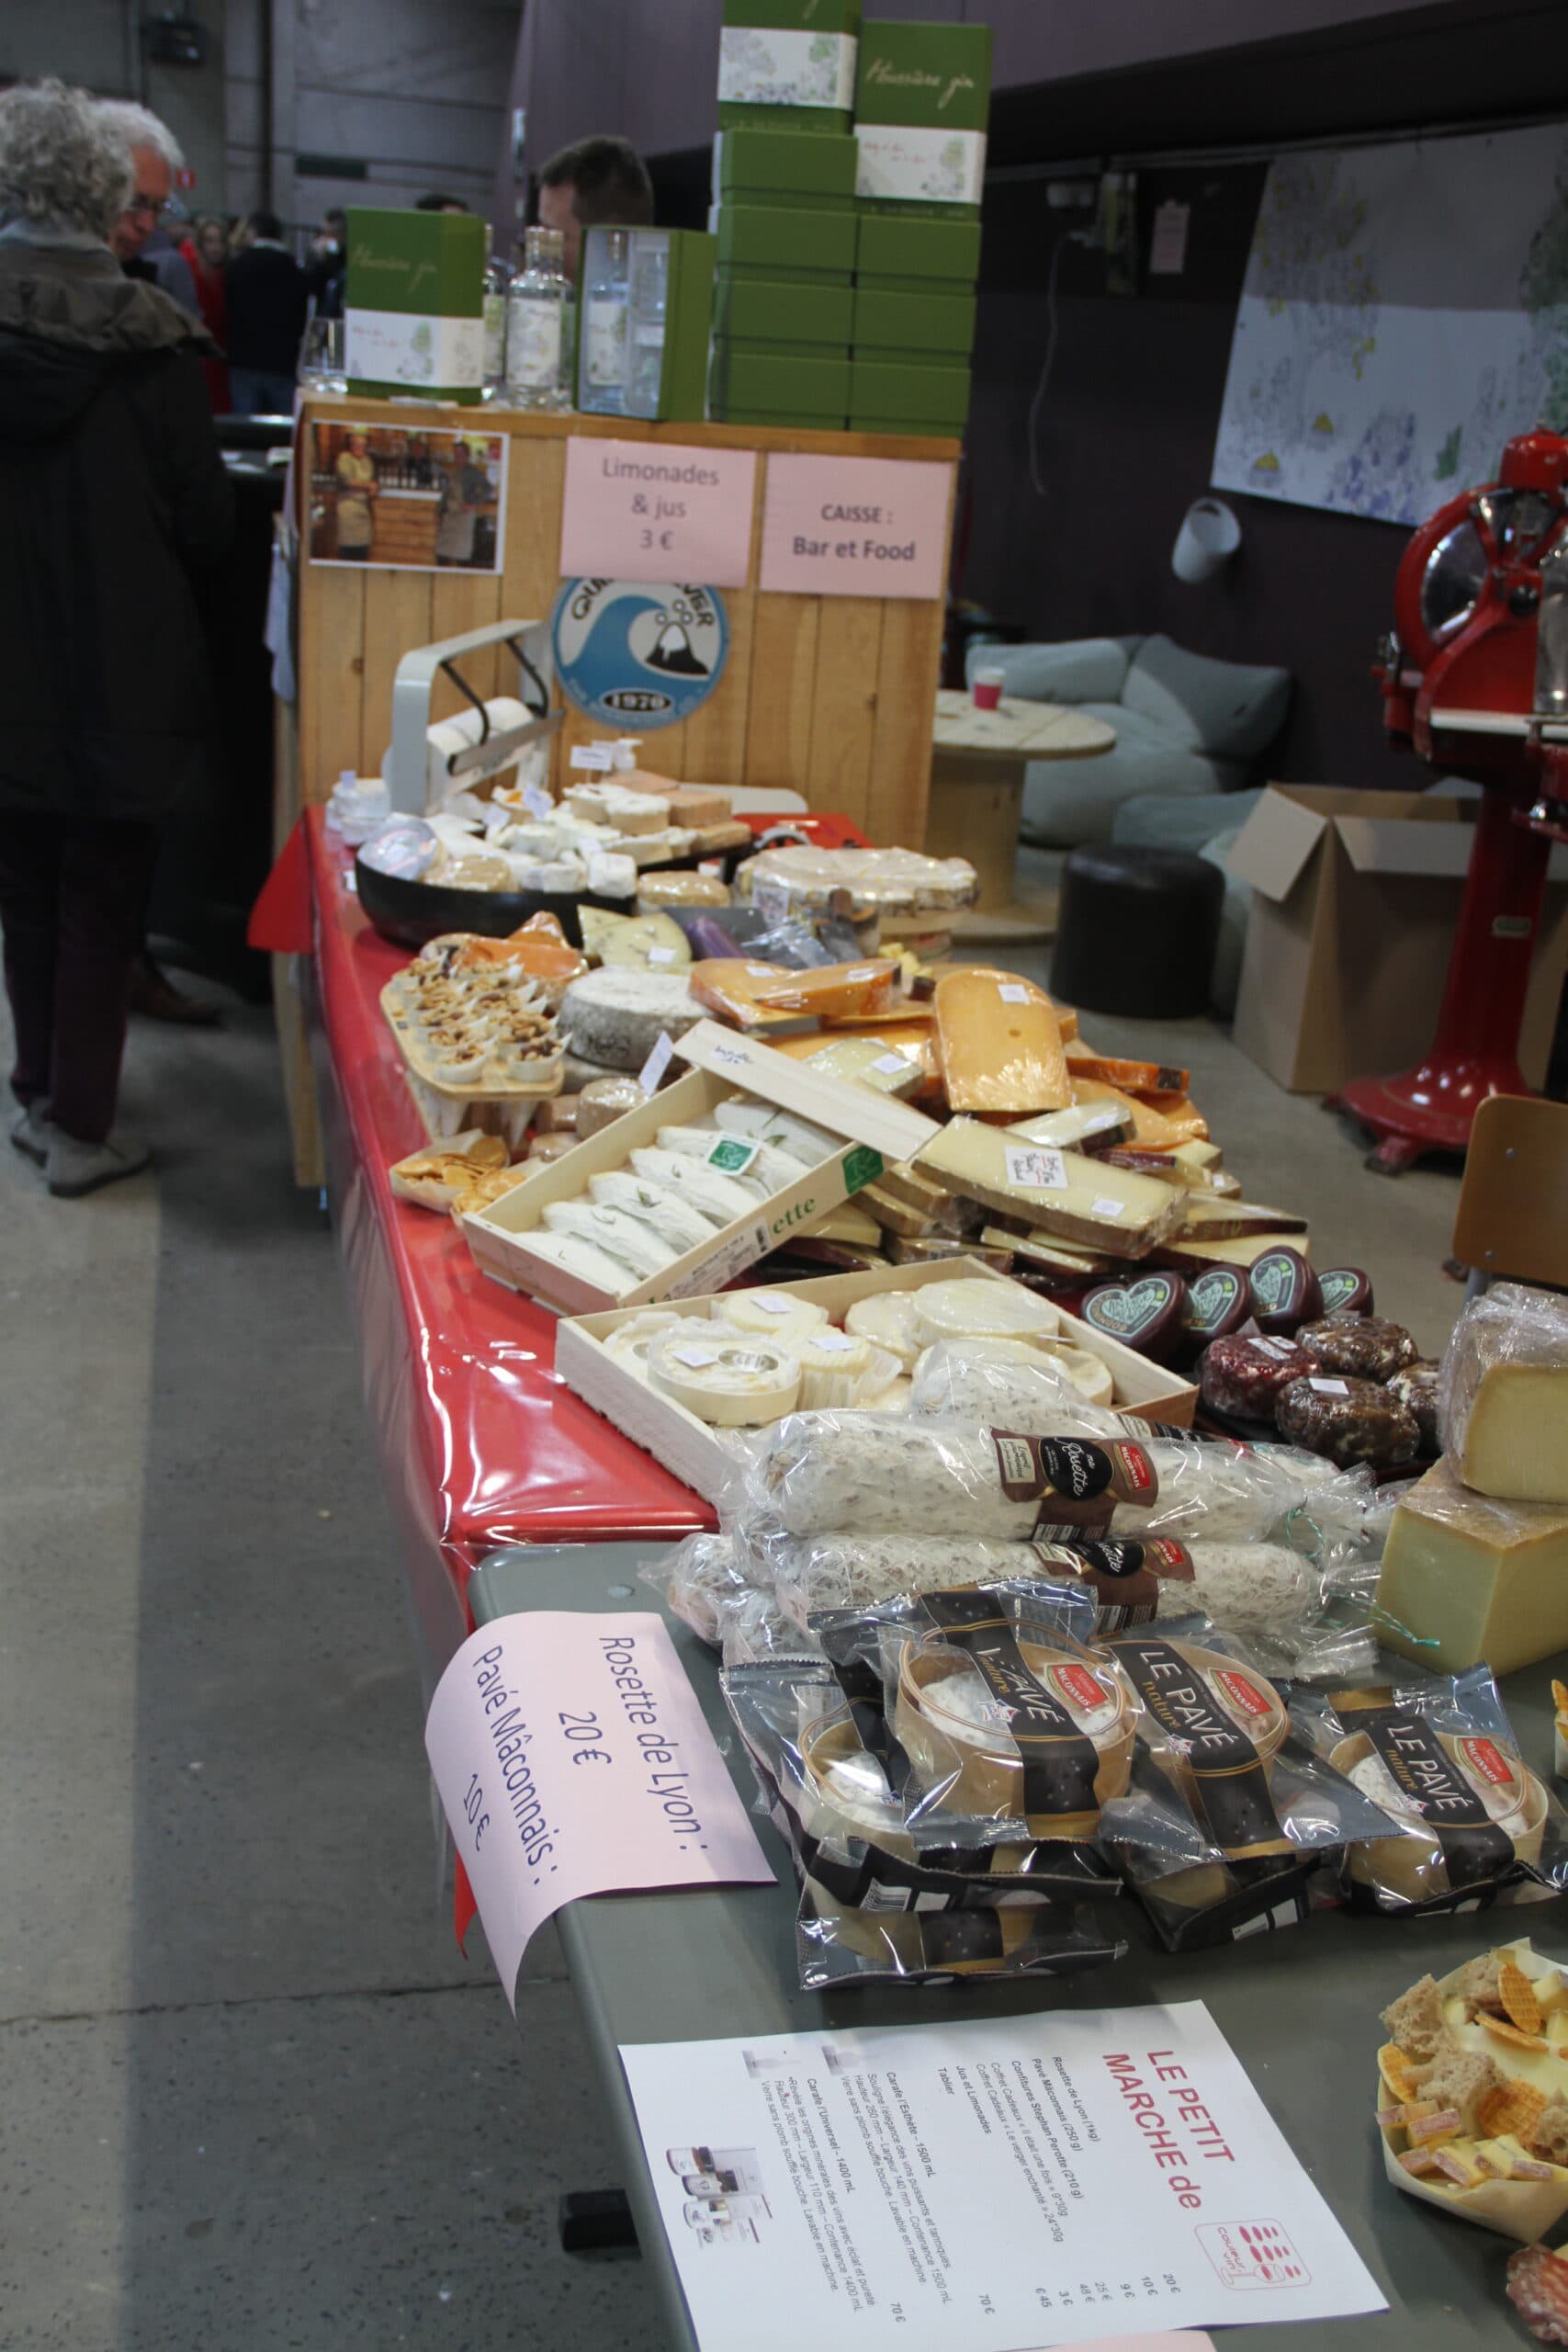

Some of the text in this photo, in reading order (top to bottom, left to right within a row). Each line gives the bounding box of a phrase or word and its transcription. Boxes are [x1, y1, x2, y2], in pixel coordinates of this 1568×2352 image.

[602, 458, 719, 486] Limonades
[631, 494, 687, 520] & jus
[821, 504, 882, 524] CAISSE
[640, 529, 673, 550] 3 €
[793, 537, 915, 561] Bar et Food
[1054, 1436, 1089, 1497] Rosette
[1139, 1652, 1182, 1679] LE
[1166, 1687, 1240, 1748] PAVÉ
[472, 1645, 560, 1867] Pavé Mâconnais
[558, 1711, 613, 1765] 20 €
[599, 1637, 702, 1834] Rosette de Lyon
[1387, 1725, 1427, 1752] LE
[1407, 1759, 1474, 1811] PAVÉ
[807, 2078, 824, 2106] Carafe
[955, 2065, 968, 2080] Jus
[963, 2081, 974, 2091] et
[966, 2090, 992, 2134] Limonades
[1010, 2060, 1035, 2102] Confitures
[1047, 2137, 1067, 2168] Perotte
[1061, 2169, 1080, 2188] (210
[1101, 2053, 1201, 2209] MARCHE de
[1146, 2050, 1235, 2162] LE PETIT
[836, 2157, 852, 2178] 1400
[843, 2179, 856, 2194] mL
[886, 2072, 904, 2098] Carafe
[915, 2143, 931, 2164] 1500
[924, 2165, 937, 2178] mL
[978, 2293, 992, 2306] 70
[937, 2066, 955, 2096] Tablier
[1040, 2295, 1053, 2308] 45
[976, 2064, 994, 2089] Coffret
[987, 2089, 1008, 2122] Cadeaux
[1005, 2131, 1016, 2142] Le
[1011, 2142, 1029, 2166] verger
[1079, 2283, 1092, 2295] 48
[990, 2062, 1008, 2087] Coffret
[1002, 2087, 1022, 2121] Cadeaux
[1032, 2154, 1045, 2169] une
[1040, 2169, 1053, 2185] fois
[1094, 2281, 1109, 2293] 25
[1051, 2056, 1072, 2087] Rosette
[1066, 2087, 1078, 2099] de
[1072, 2099, 1089, 2120] Lyon
[1082, 2120, 1101, 2142] (1kg)
[1162, 2273, 1177, 2286] 20
[1061, 2122, 1079, 2142] (250
[1141, 2276, 1155, 2288] 10
[889, 2301, 903, 2314] 70
